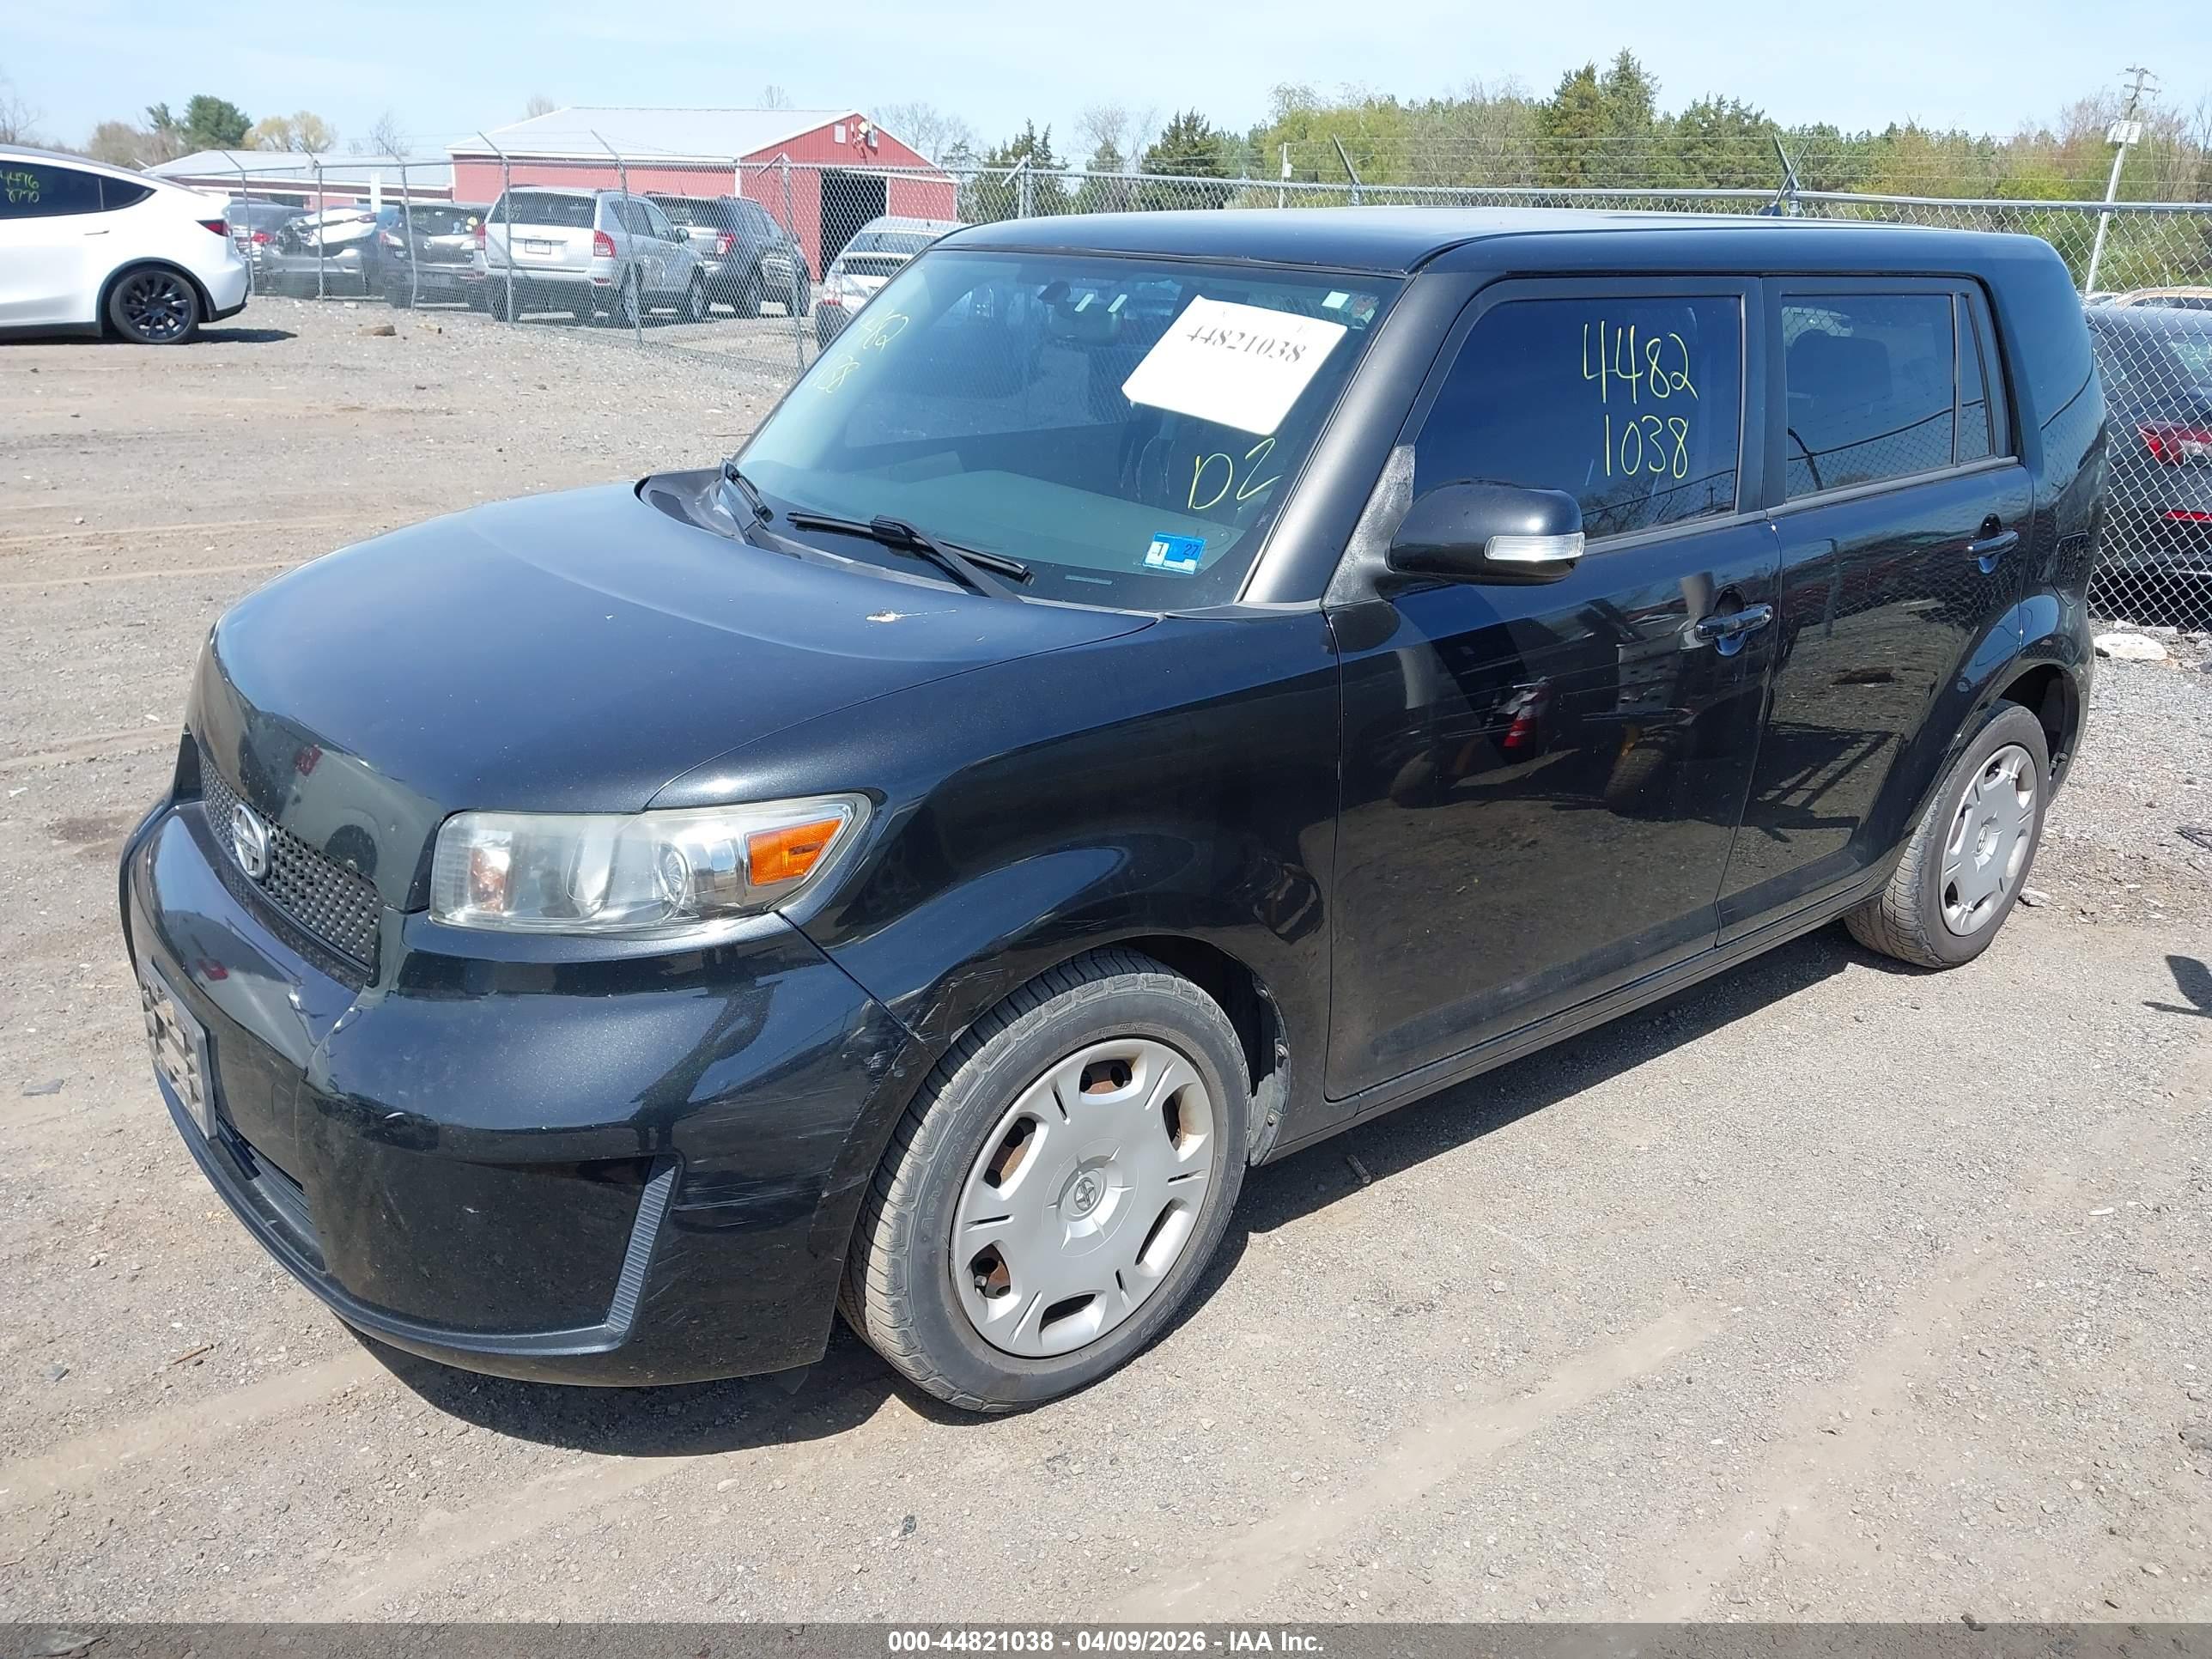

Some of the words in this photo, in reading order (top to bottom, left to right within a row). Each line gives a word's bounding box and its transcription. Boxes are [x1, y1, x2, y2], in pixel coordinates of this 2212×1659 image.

[1187, 325, 1307, 363] 44821038
[1583, 319, 1699, 405] 4482
[1604, 413, 1689, 479] 1038
[1182, 544, 1200, 556] 27
